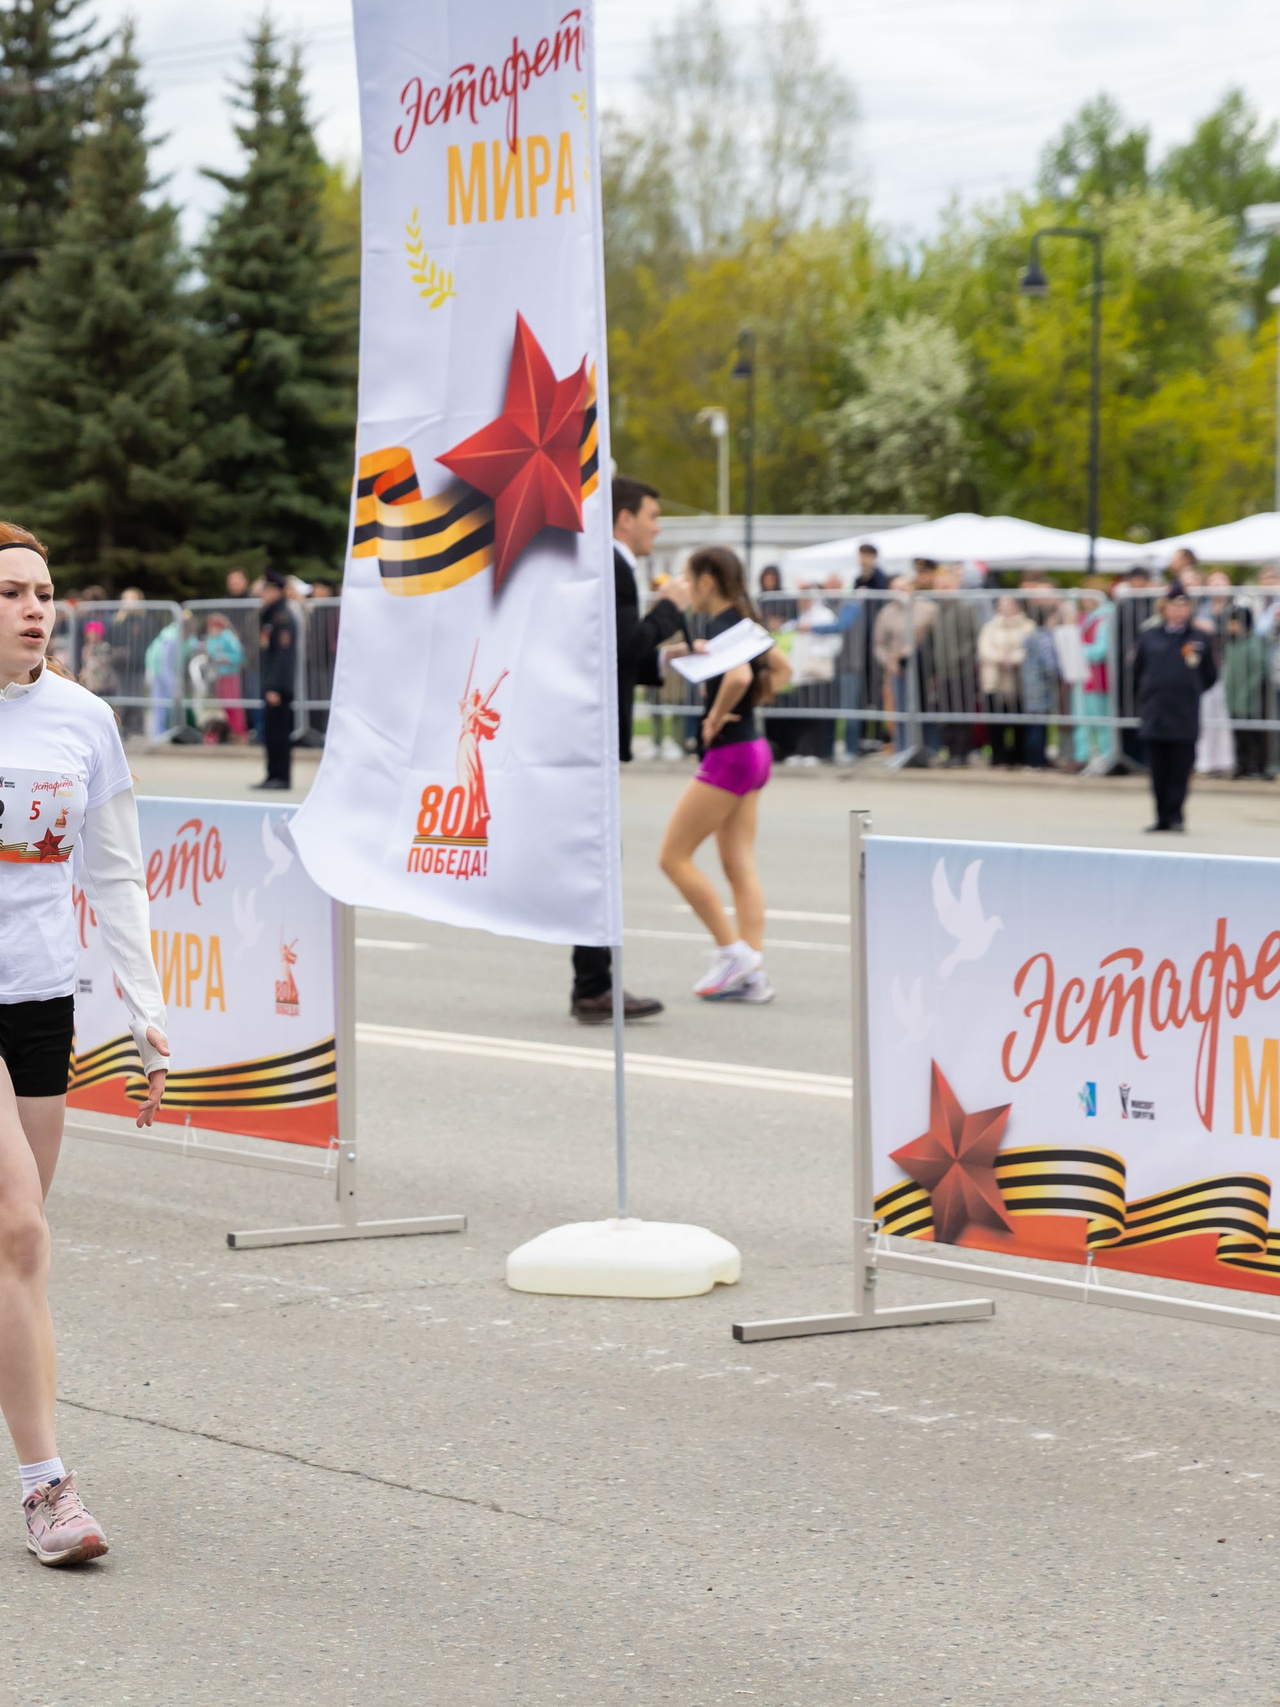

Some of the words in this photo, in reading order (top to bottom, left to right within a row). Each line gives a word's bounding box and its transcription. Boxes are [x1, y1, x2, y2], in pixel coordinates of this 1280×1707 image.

[447, 131, 575, 226] МИРА
[30, 779, 74, 798] Эстафета
[29, 800, 41, 821] 5
[416, 784, 466, 836] 80
[407, 847, 488, 880] ПОБЕДА!
